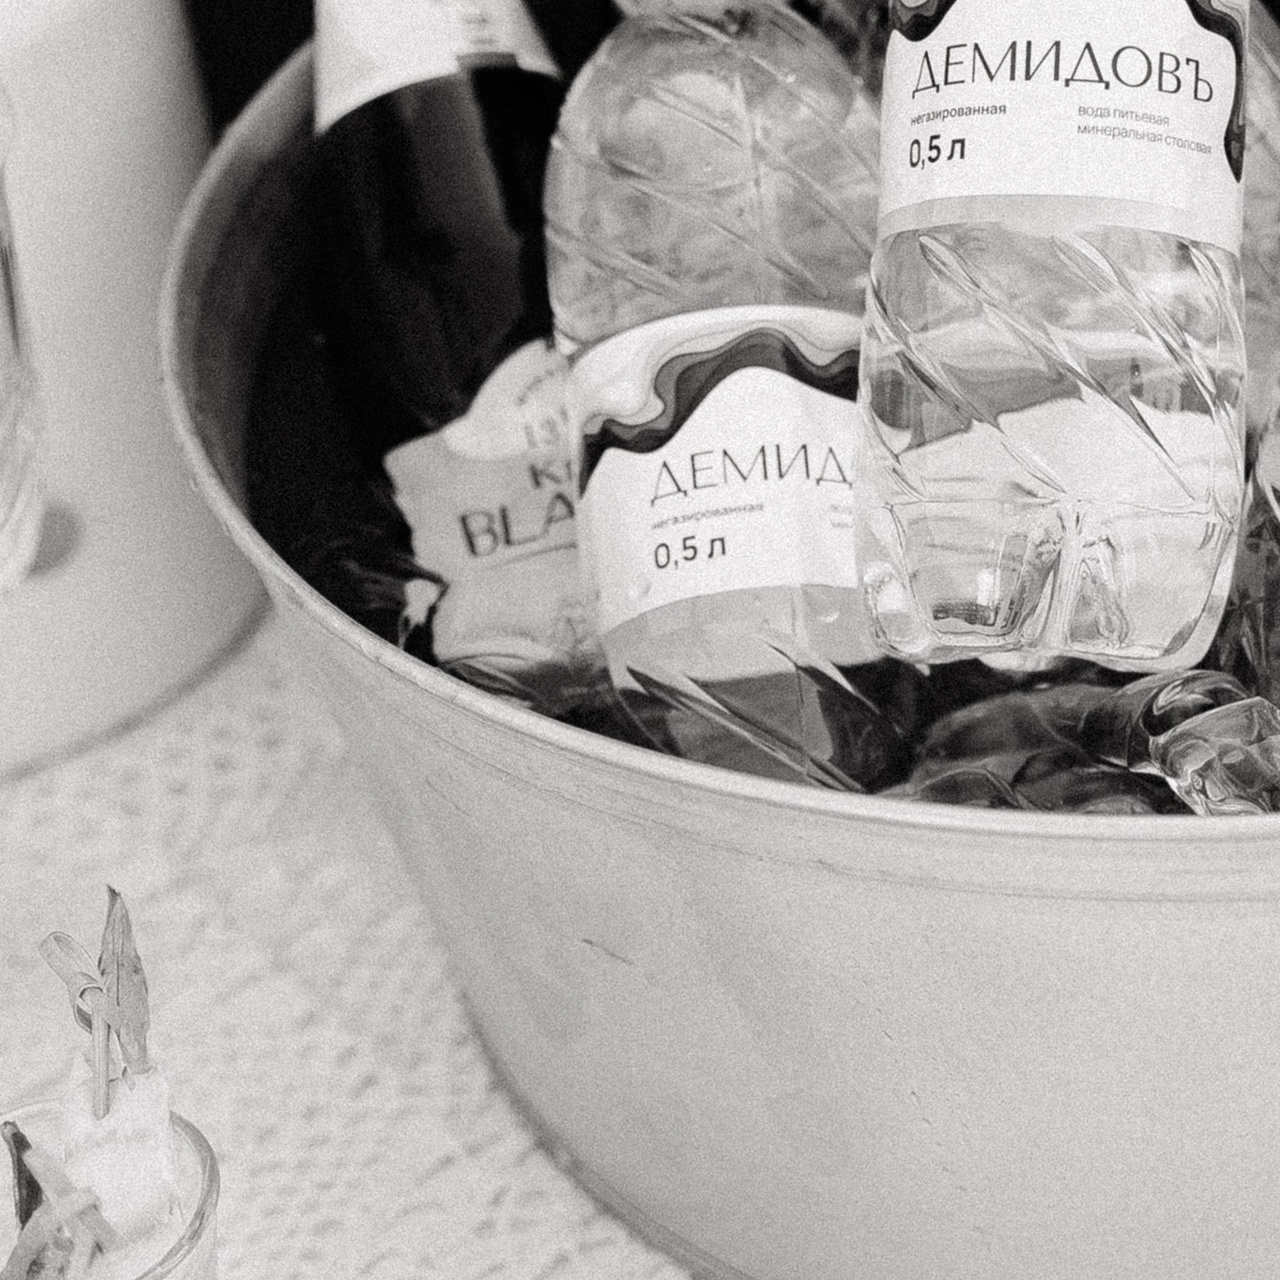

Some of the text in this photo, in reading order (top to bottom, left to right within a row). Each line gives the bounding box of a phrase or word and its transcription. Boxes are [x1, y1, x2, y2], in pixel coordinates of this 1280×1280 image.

[912, 39, 1213, 103] ДЕМИДОВЪ
[910, 104, 1008, 126] негазированная
[1077, 105, 1170, 127] вода питьевая
[909, 133, 966, 171] 0,5 л
[1077, 124, 1213, 155] минеральная столовая
[650, 443, 853, 508] ДЕМИД
[654, 534, 727, 570] 0,5 л
